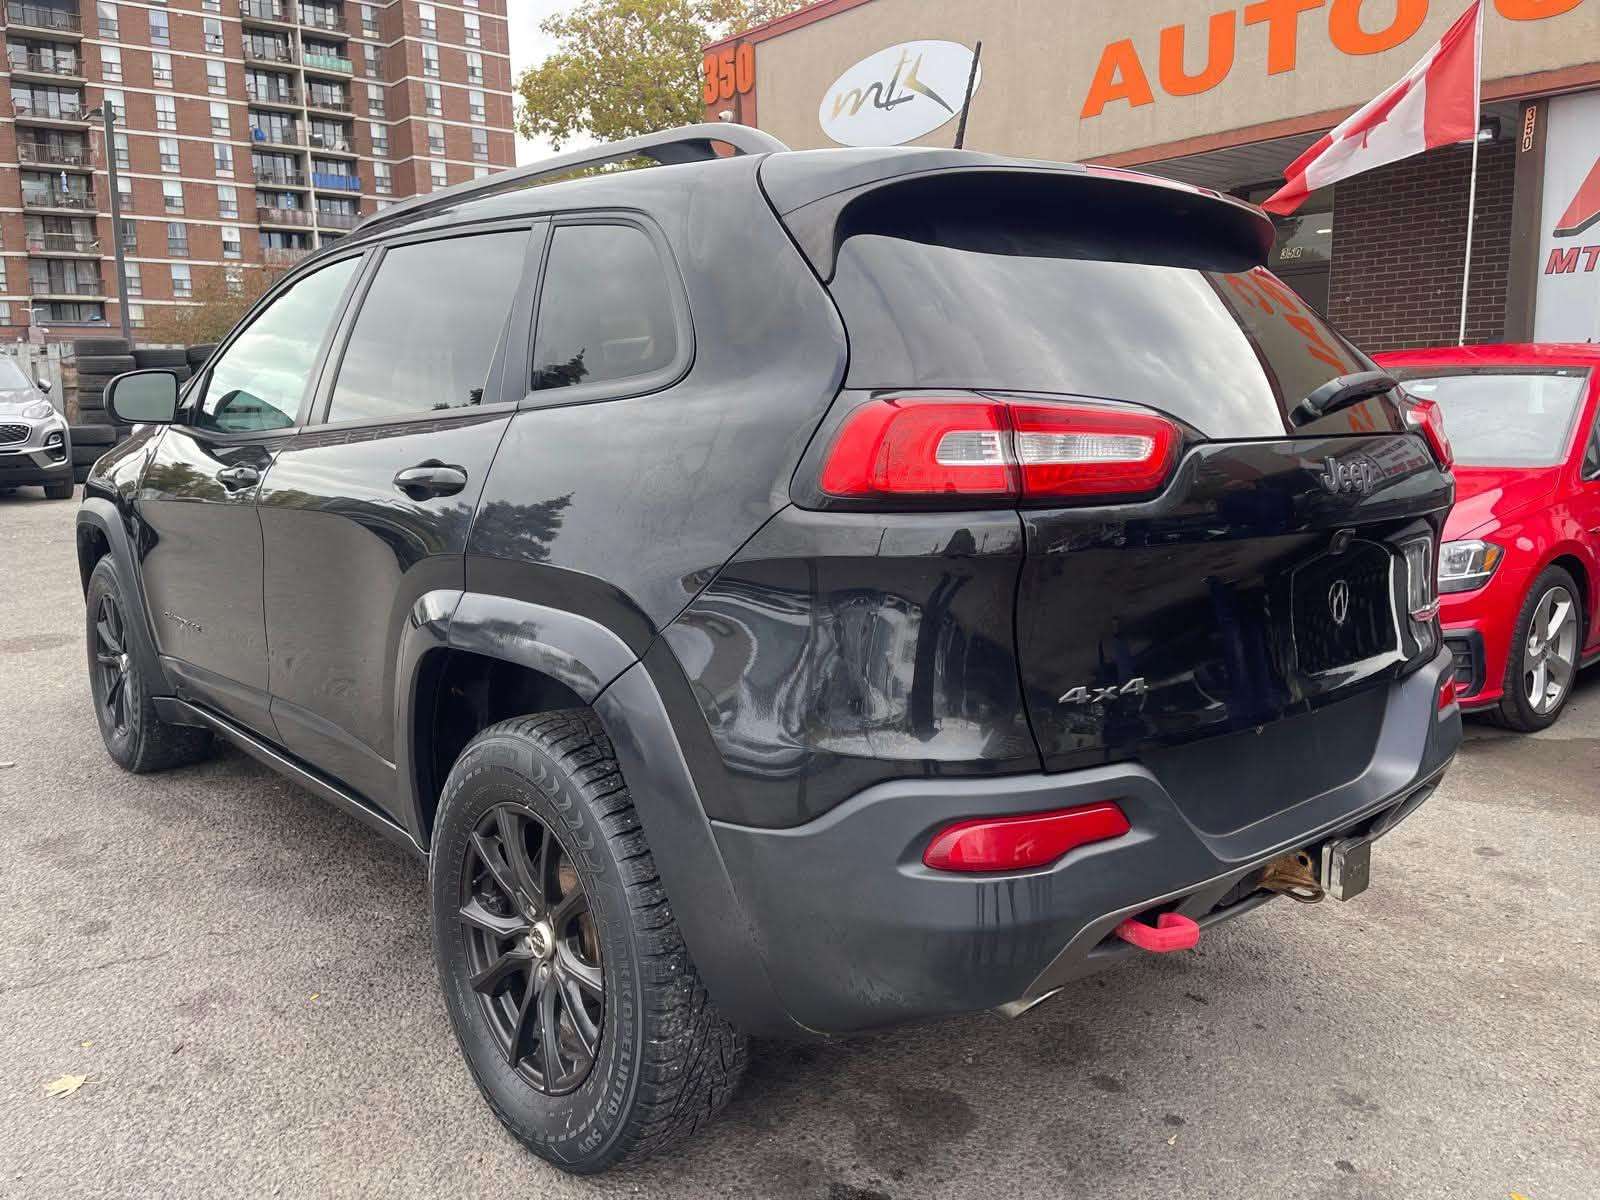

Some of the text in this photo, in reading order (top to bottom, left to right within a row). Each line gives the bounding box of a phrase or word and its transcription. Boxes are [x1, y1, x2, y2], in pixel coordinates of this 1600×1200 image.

[704, 43, 755, 105] 350
[1079, 0, 1429, 119] AUTO
[1522, 102, 1536, 151] 350
[1320, 456, 1376, 496] Jeep
